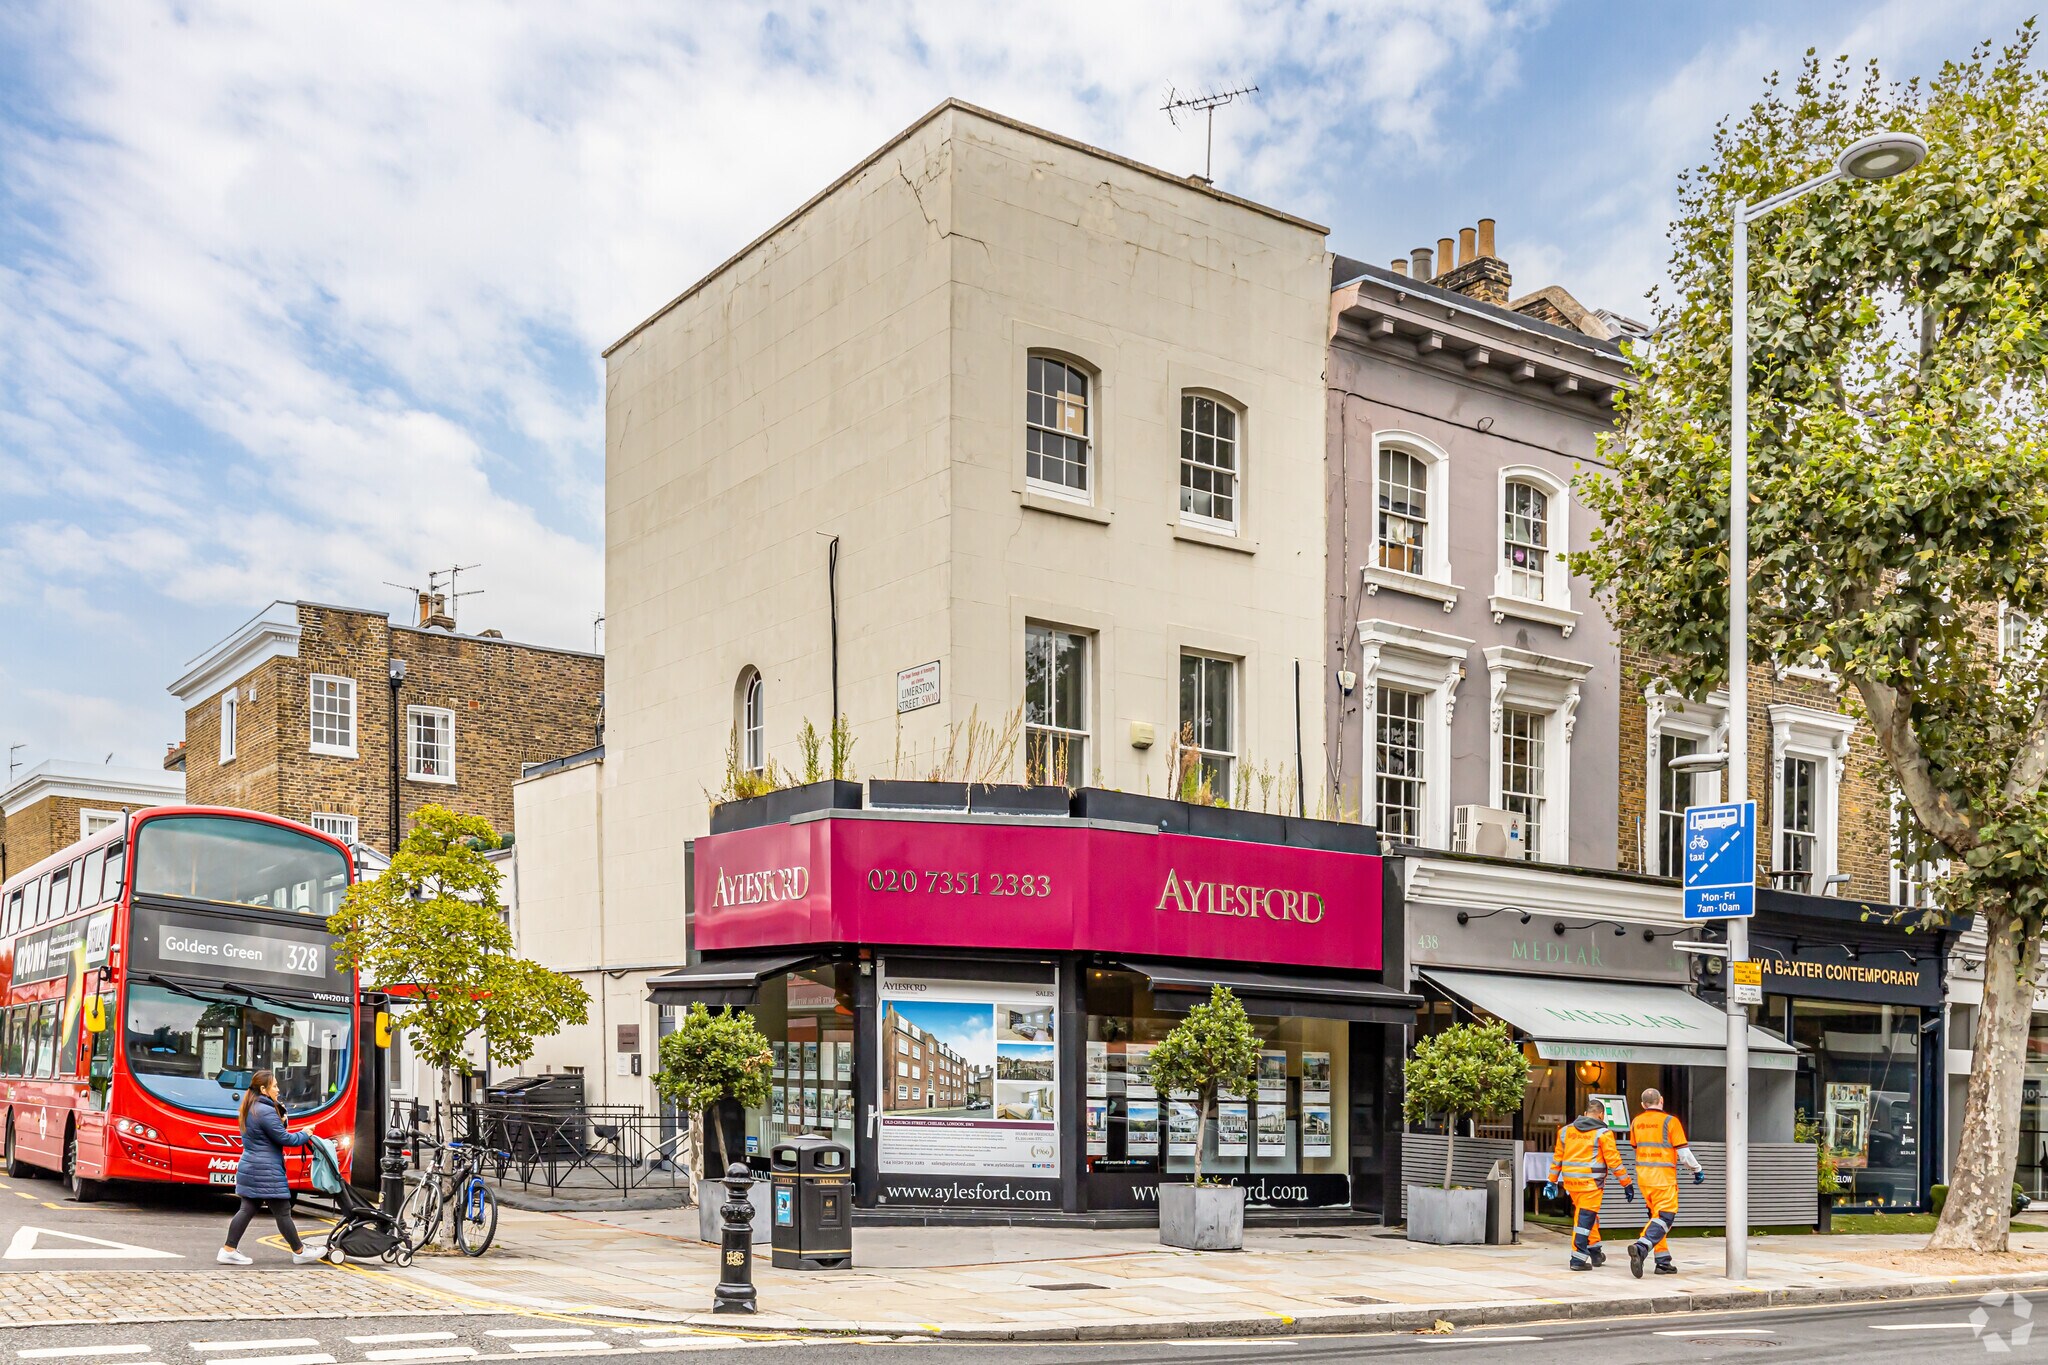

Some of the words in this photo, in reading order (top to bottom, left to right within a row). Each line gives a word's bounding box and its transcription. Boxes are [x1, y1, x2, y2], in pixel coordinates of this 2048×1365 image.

[1689, 852, 1705, 862] taxi
[712, 866, 809, 908] AYLESFORD
[867, 868, 918, 893] 020
[925, 871, 982, 896] 7351
[989, 873, 1052, 898] 2383
[1155, 868, 1326, 925] AYLESFORD
[1418, 935, 1439, 950] 438
[1512, 940, 1603, 967] MEDLAR
[165, 936, 218, 956] Golders
[223, 944, 263, 961] Green
[286, 945, 318, 972] 328
[1775, 960, 1823, 979] BAXTER
[1825, 964, 1920, 987] CONTEMPORARY
[882, 981, 927, 992] AYLESFORD
[312, 993, 350, 1004] VWH2018
[1543, 1007, 1699, 1031] MEDLAR
[1542, 1045, 1577, 1057] MEDLAR
[1579, 1047, 1634, 1059] RESTAURANT
[213, 1174, 236, 1183] LK14
[886, 1182, 1052, 1202] www.aylesford.com
